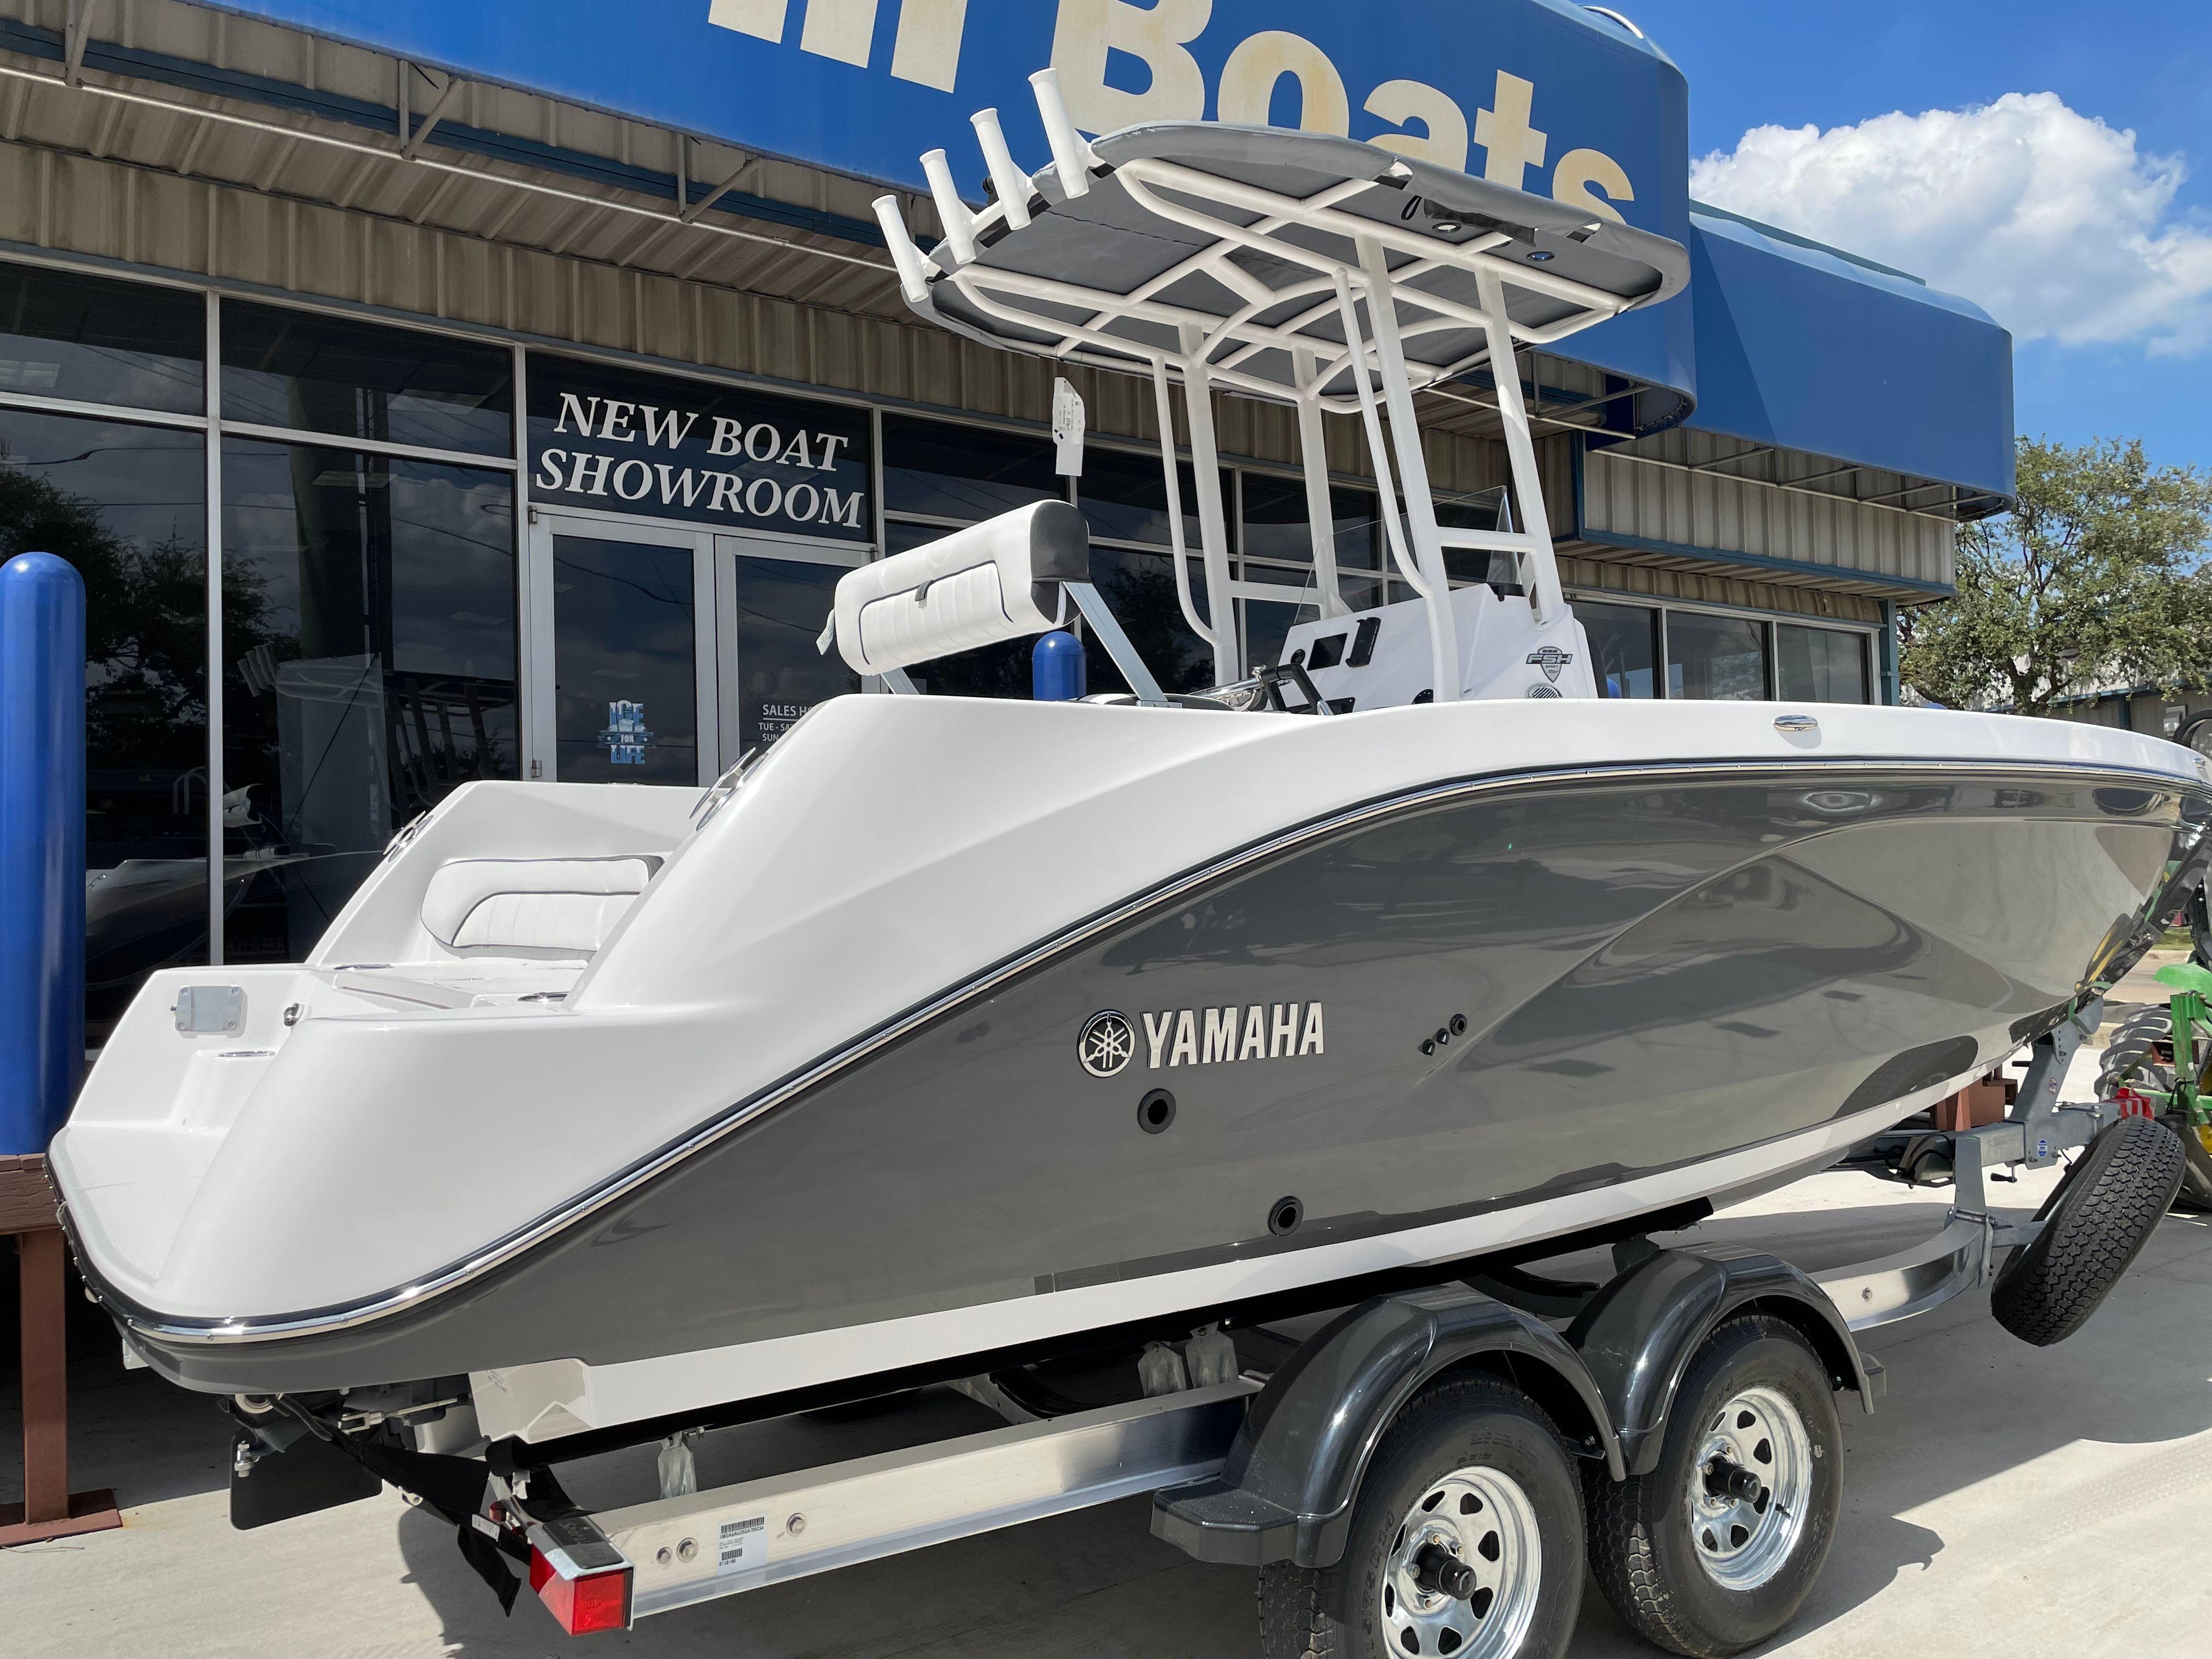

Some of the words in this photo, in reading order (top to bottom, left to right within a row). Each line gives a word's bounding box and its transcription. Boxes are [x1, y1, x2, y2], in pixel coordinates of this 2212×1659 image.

[1049, 0, 1635, 225] Boats
[553, 392, 699, 450] NEW
[707, 416, 849, 472] BOAT
[535, 448, 864, 529] SHOWROOM
[1526, 653, 1573, 664] FSH
[609, 699, 644, 729] ICE
[762, 704, 797, 717] SALES
[758, 721, 775, 731] TUE
[780, 723, 794, 732] SA
[620, 735, 634, 743] FOR
[761, 733, 779, 742] SUN
[610, 744, 646, 764] LIFE
[1141, 1001, 1325, 1069] YAMAHA
